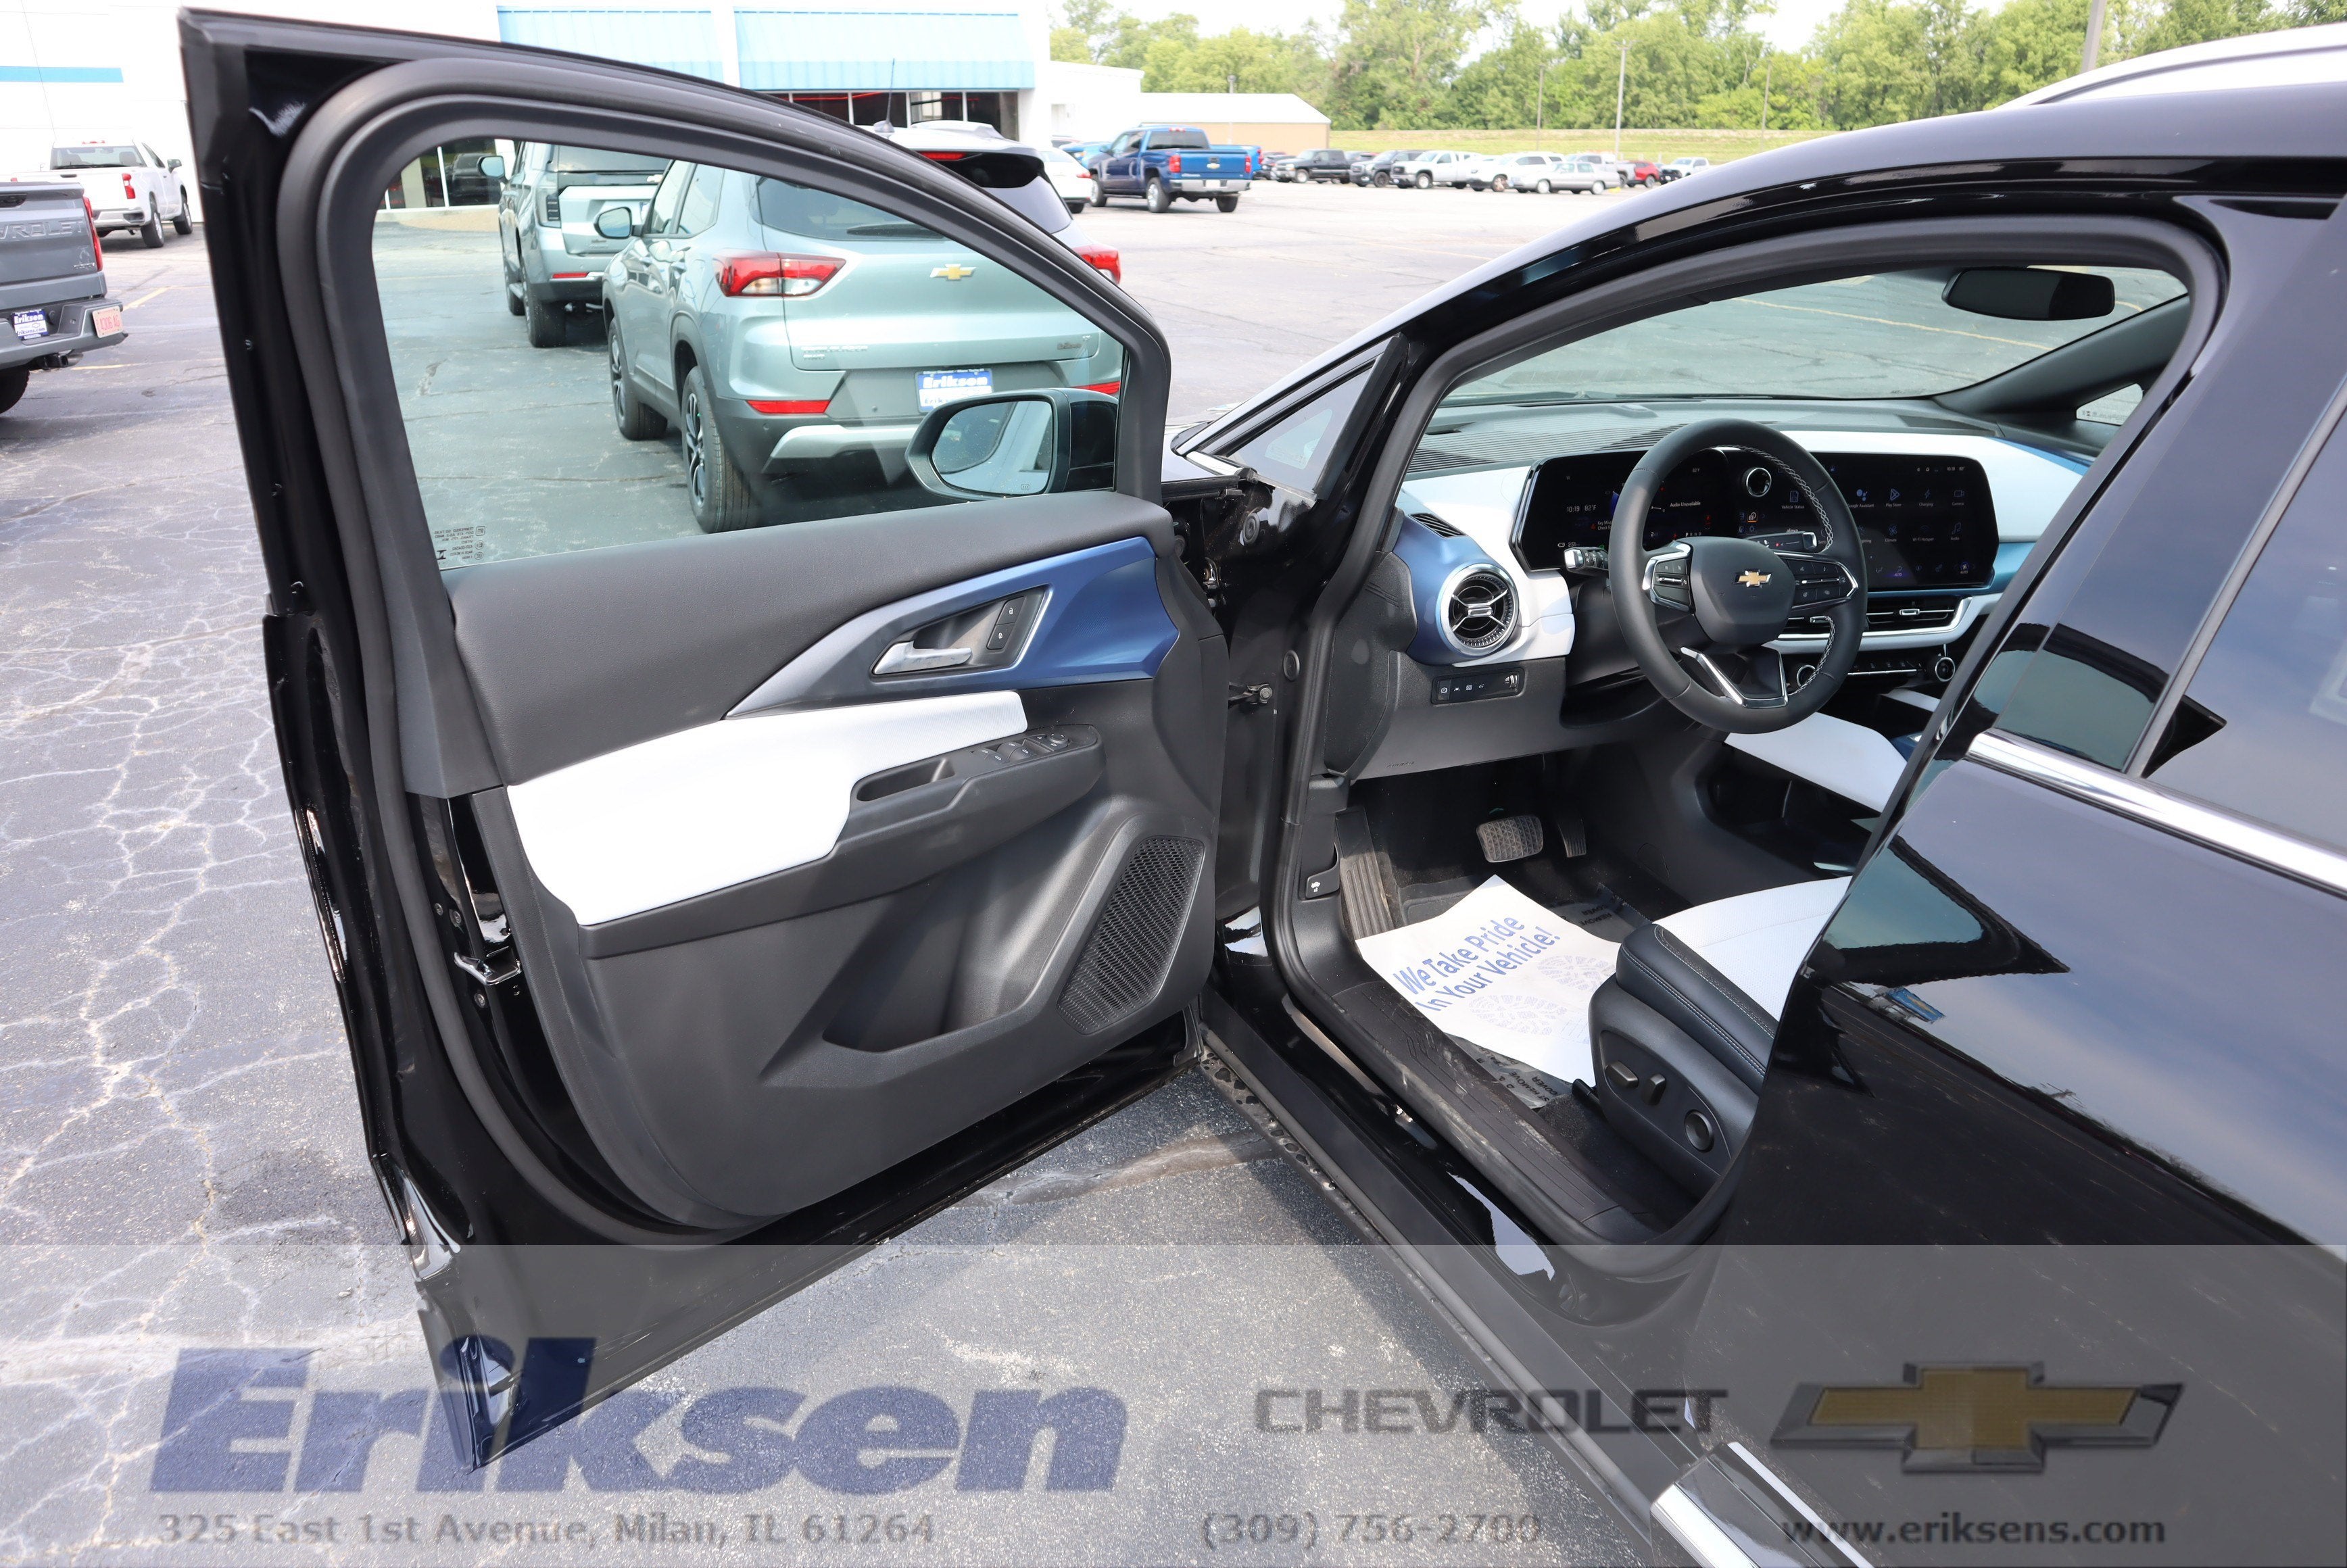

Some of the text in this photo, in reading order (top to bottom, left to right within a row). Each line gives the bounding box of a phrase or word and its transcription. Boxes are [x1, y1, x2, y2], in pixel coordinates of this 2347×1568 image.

[14, 314, 43, 324] Eriksen
[923, 375, 988, 389] Eriksen
[1393, 917, 1525, 995] We Take Pride
[1415, 926, 1561, 1011] In Your Vehicle!
[1532, 1076, 1557, 1096] COVER
